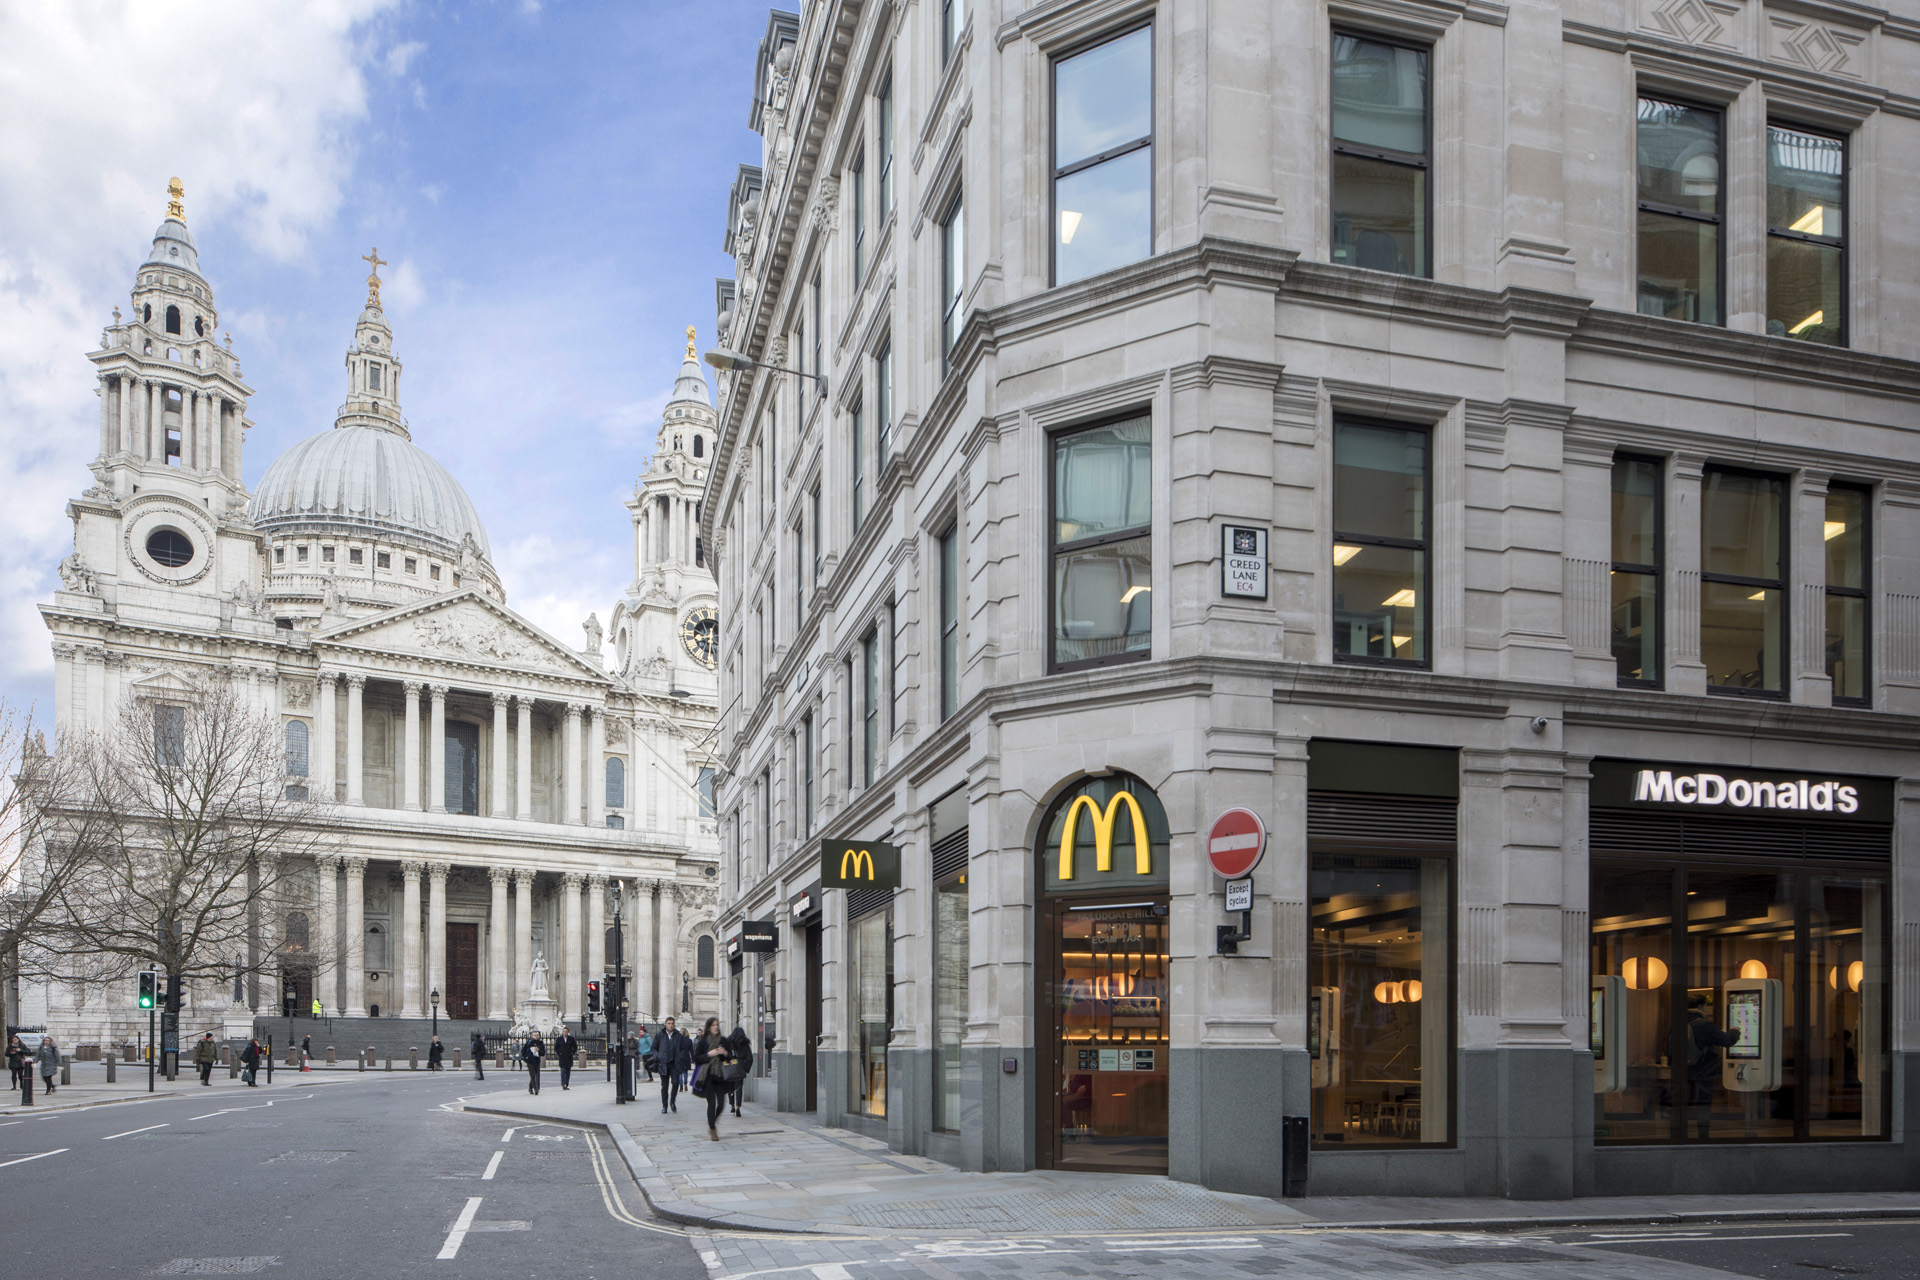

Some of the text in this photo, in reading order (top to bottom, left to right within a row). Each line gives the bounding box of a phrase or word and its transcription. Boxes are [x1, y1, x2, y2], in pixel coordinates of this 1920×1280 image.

[1230, 559, 1260, 570] CREED
[1233, 570, 1257, 581] LANE
[1237, 582, 1253, 591] EC4
[1635, 769, 1859, 814] McDonald's
[1229, 884, 1248, 894] Except
[1229, 896, 1247, 906] cycles
[1090, 910, 1133, 920] LUDGATE
[1135, 909, 1156, 918] HILL
[1092, 935, 1118, 944] EC4M
